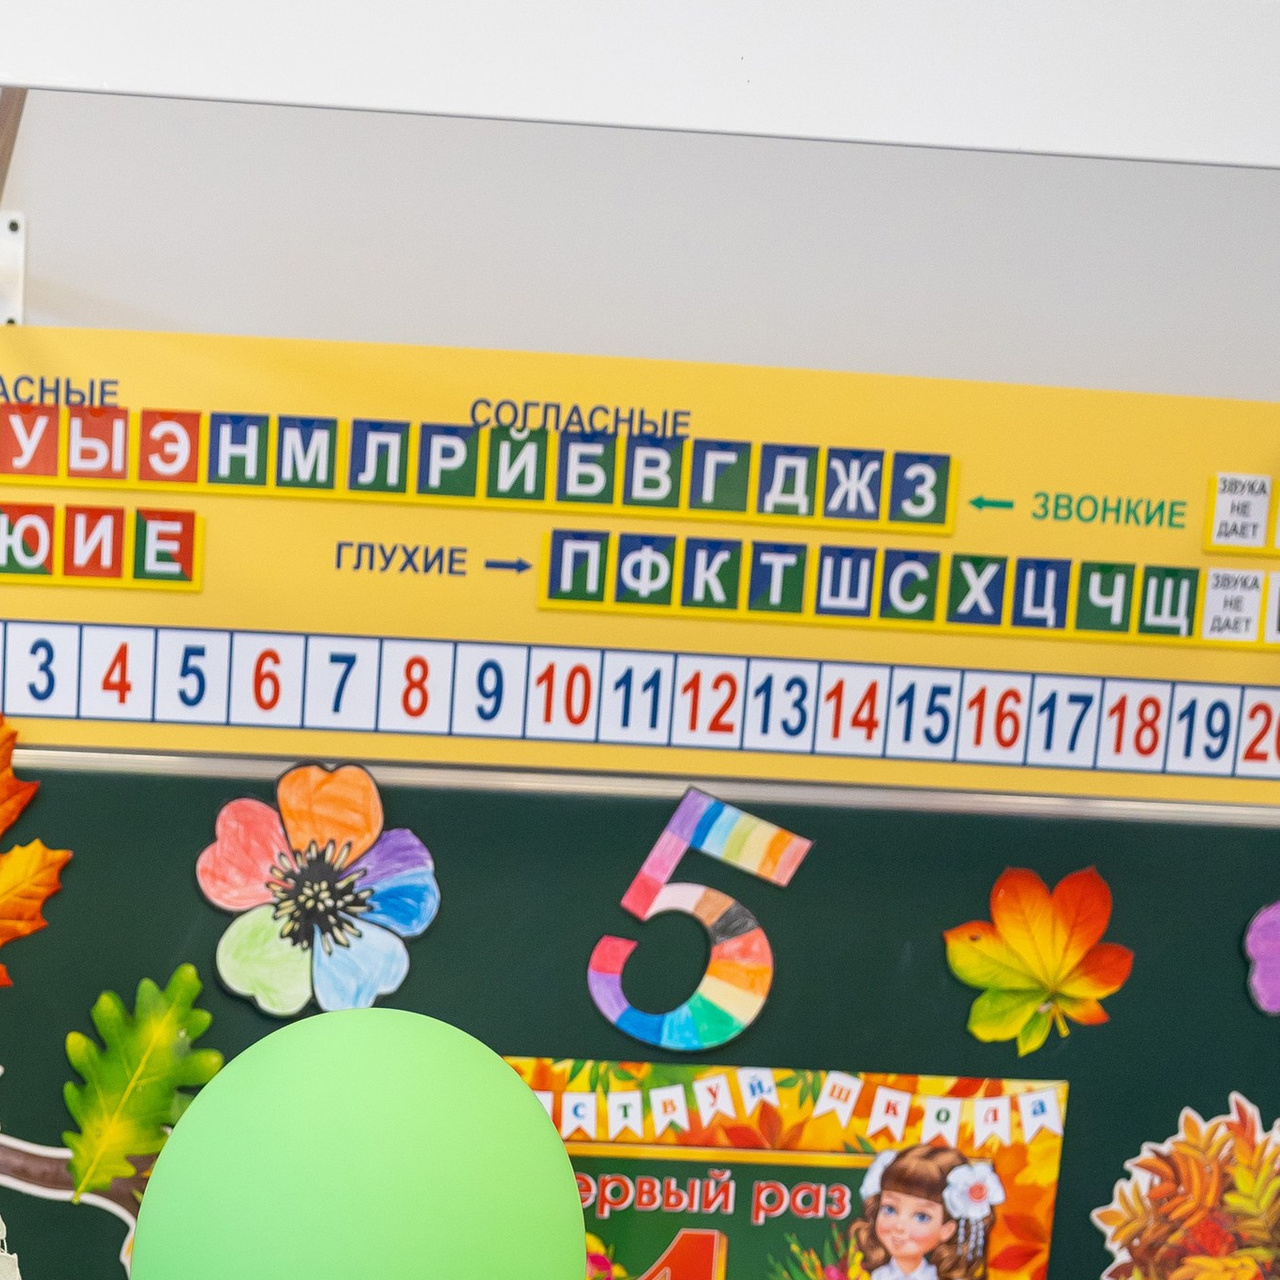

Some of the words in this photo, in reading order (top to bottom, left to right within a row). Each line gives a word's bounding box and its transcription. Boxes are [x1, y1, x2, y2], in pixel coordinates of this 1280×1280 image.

[470, 400, 691, 439] СОГЛАСНЫЕ
[1218, 475, 1268, 495] ЗВУКА
[1032, 491, 1187, 529] ЗВОНКИЕ
[1229, 499, 1252, 517] НЕ
[1216, 519, 1260, 539] ДАЕТ
[335, 542, 468, 576] ГЛУХИЕ
[1211, 572, 1262, 591] ЗВУКА
[1222, 595, 1245, 612] НЕ
[1208, 614, 1253, 633] ДАЕТ
[28, 639, 55, 701] 3
[102, 643, 132, 704] 4
[178, 646, 206, 707] 5
[253, 649, 281, 711] 6
[329, 653, 357, 713] 7
[402, 656, 429, 718] 8
[477, 660, 504, 721] 9
[536, 663, 592, 726] 10
[614, 668, 664, 730] 11
[682, 671, 738, 733] 12
[754, 675, 808, 737] 13
[825, 679, 879, 741] 14
[897, 682, 952, 745] 15
[968, 687, 1022, 749] 16
[1038, 691, 1094, 752] 17
[1108, 695, 1161, 756] 18
[1178, 698, 1231, 760] 19
[1243, 702, 1280, 762] 2
[571, 1074, 773, 1122] ствуй,
[577, 1167, 737, 1221] ервый
[751, 1178, 853, 1225] раз
